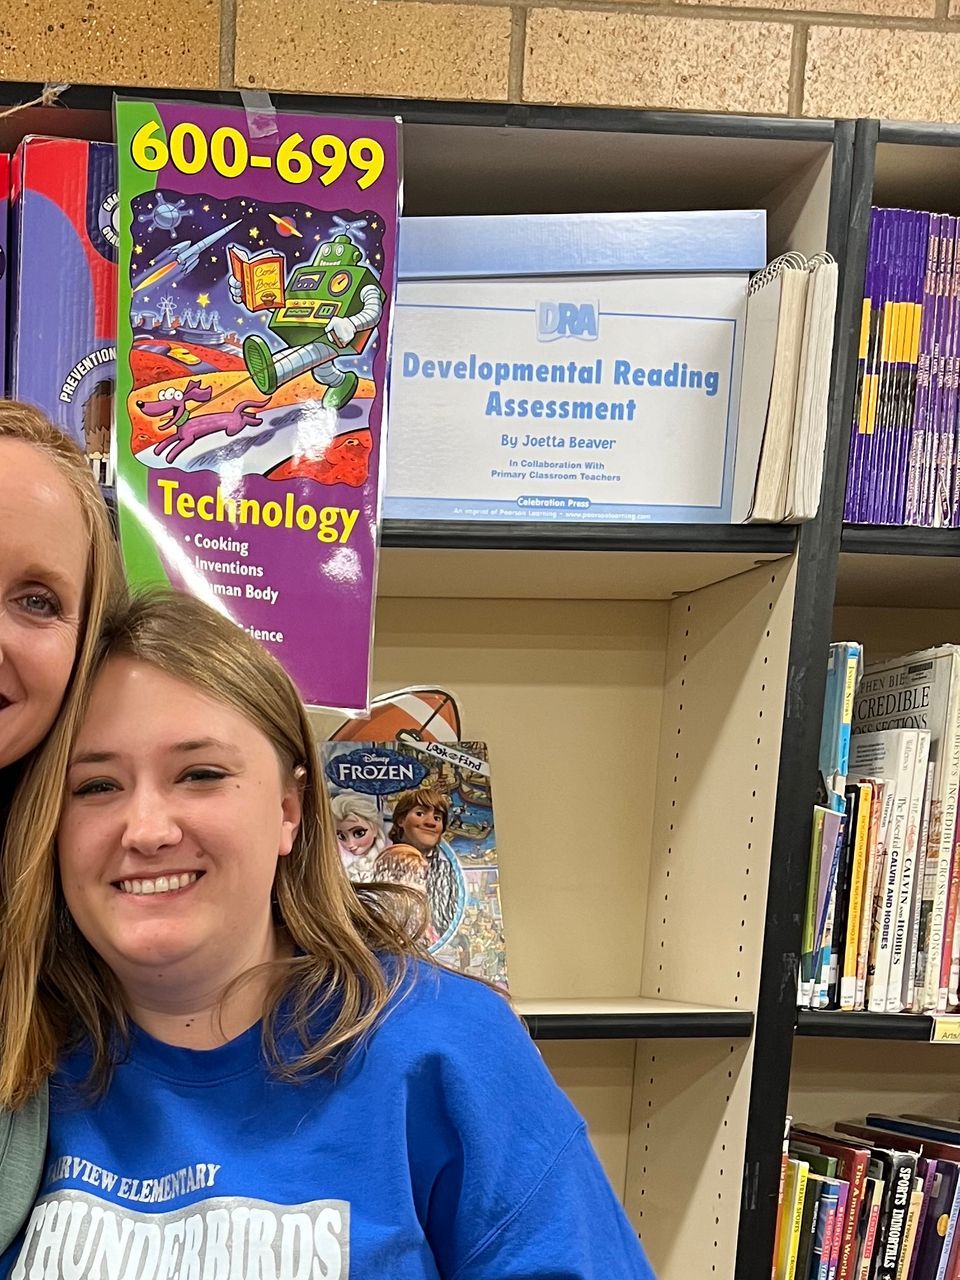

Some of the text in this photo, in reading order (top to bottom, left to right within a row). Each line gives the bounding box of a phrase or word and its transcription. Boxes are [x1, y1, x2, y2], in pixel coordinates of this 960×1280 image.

[131, 120, 386, 190] 600-699
[539, 302, 597, 337] DRA
[402, 351, 720, 397] Developmental Reading
[485, 390, 637, 421] Assessment
[501, 434, 617, 449] By Joetta Beaver
[491, 470, 621, 482] Primary Classroom Teachers
[509, 459, 605, 471] In Collaboration With
[156, 479, 360, 543] Technology
[517, 497, 590, 508] Celebration Press
[194, 533, 249, 557] Cooking
[195, 556, 264, 577] Inventions
[210, 583, 279, 605] man Body
[338, 762, 415, 781] FROZEN
[361, 752, 390, 765] Disney
[426, 741, 484, 771] Look Find
[898, 857, 914, 904] CALVIN
[927, 781, 960, 957] INCREDIBLE CROSS-SECTIONS
[879, 850, 900, 950] CALVIN AND HOBBES
[890, 918, 906, 966] HOBBES
[117, 1163, 221, 1203] ELEMENTARY
[853, 1162, 864, 1186] The
[792, 1175, 807, 1233] EXTREME SPORTS
[844, 1187, 860, 1241] Amazing
[881, 1165, 912, 1269] SPORTS IMMORTALS
[821, 1215, 836, 1261] SCHOLASTIC
[829, 1212, 844, 1259] SCHOLASTIC
[862, 1210, 879, 1259] SCHOLASTIC
[839, 1242, 853, 1277] World
